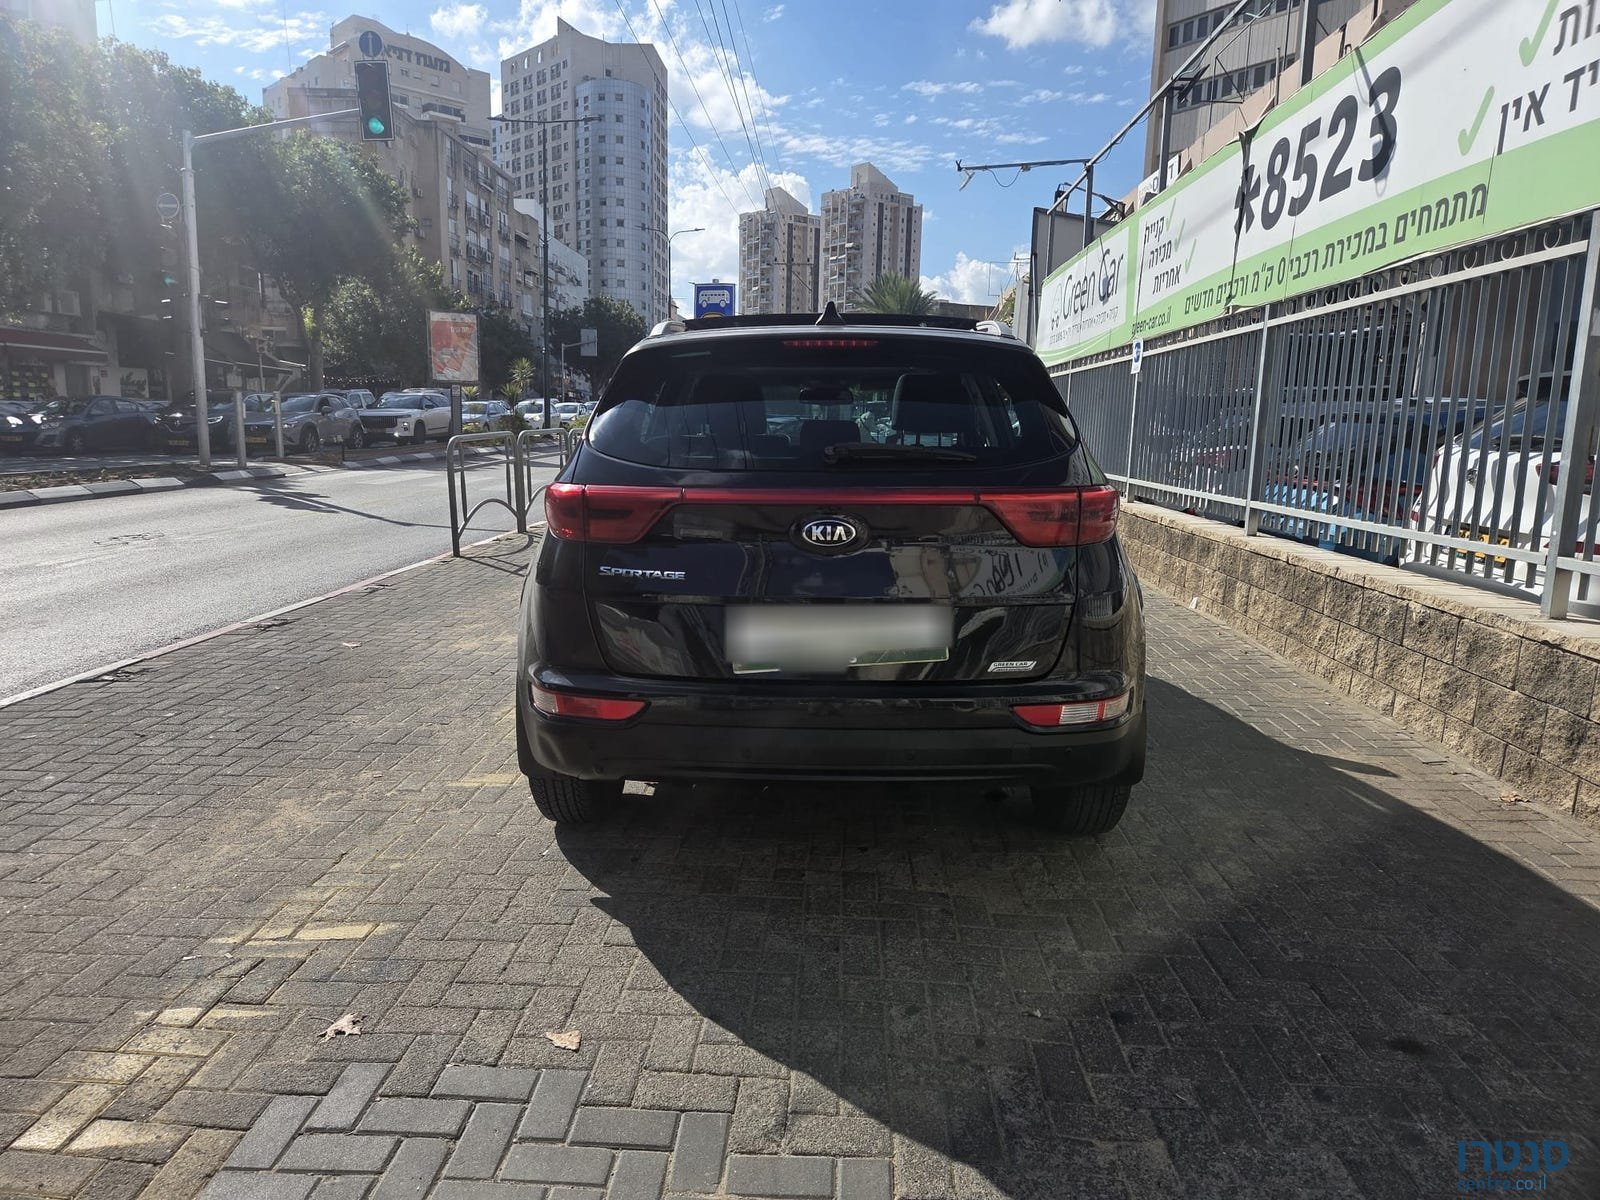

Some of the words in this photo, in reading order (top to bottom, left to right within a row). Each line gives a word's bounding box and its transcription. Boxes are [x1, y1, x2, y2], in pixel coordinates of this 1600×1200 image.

[1553, 0, 1600, 56] ות
[1497, 82, 1551, 156] אין
[1393, 183, 1488, 245] מתמחים
[1148, 240, 1172, 269] מכירה
[1322, 222, 1388, 270] במכירת
[1153, 264, 1182, 295] אחריות
[1289, 249, 1320, 281] רכבי
[1063, 271, 1096, 320] Green
[1098, 248, 1124, 302] Car
[1215, 274, 1249, 305] ורכבים
[1184, 287, 1214, 315] חדשים
[810, 525, 848, 542] KIA
[599, 566, 686, 580] SPORTAGE
